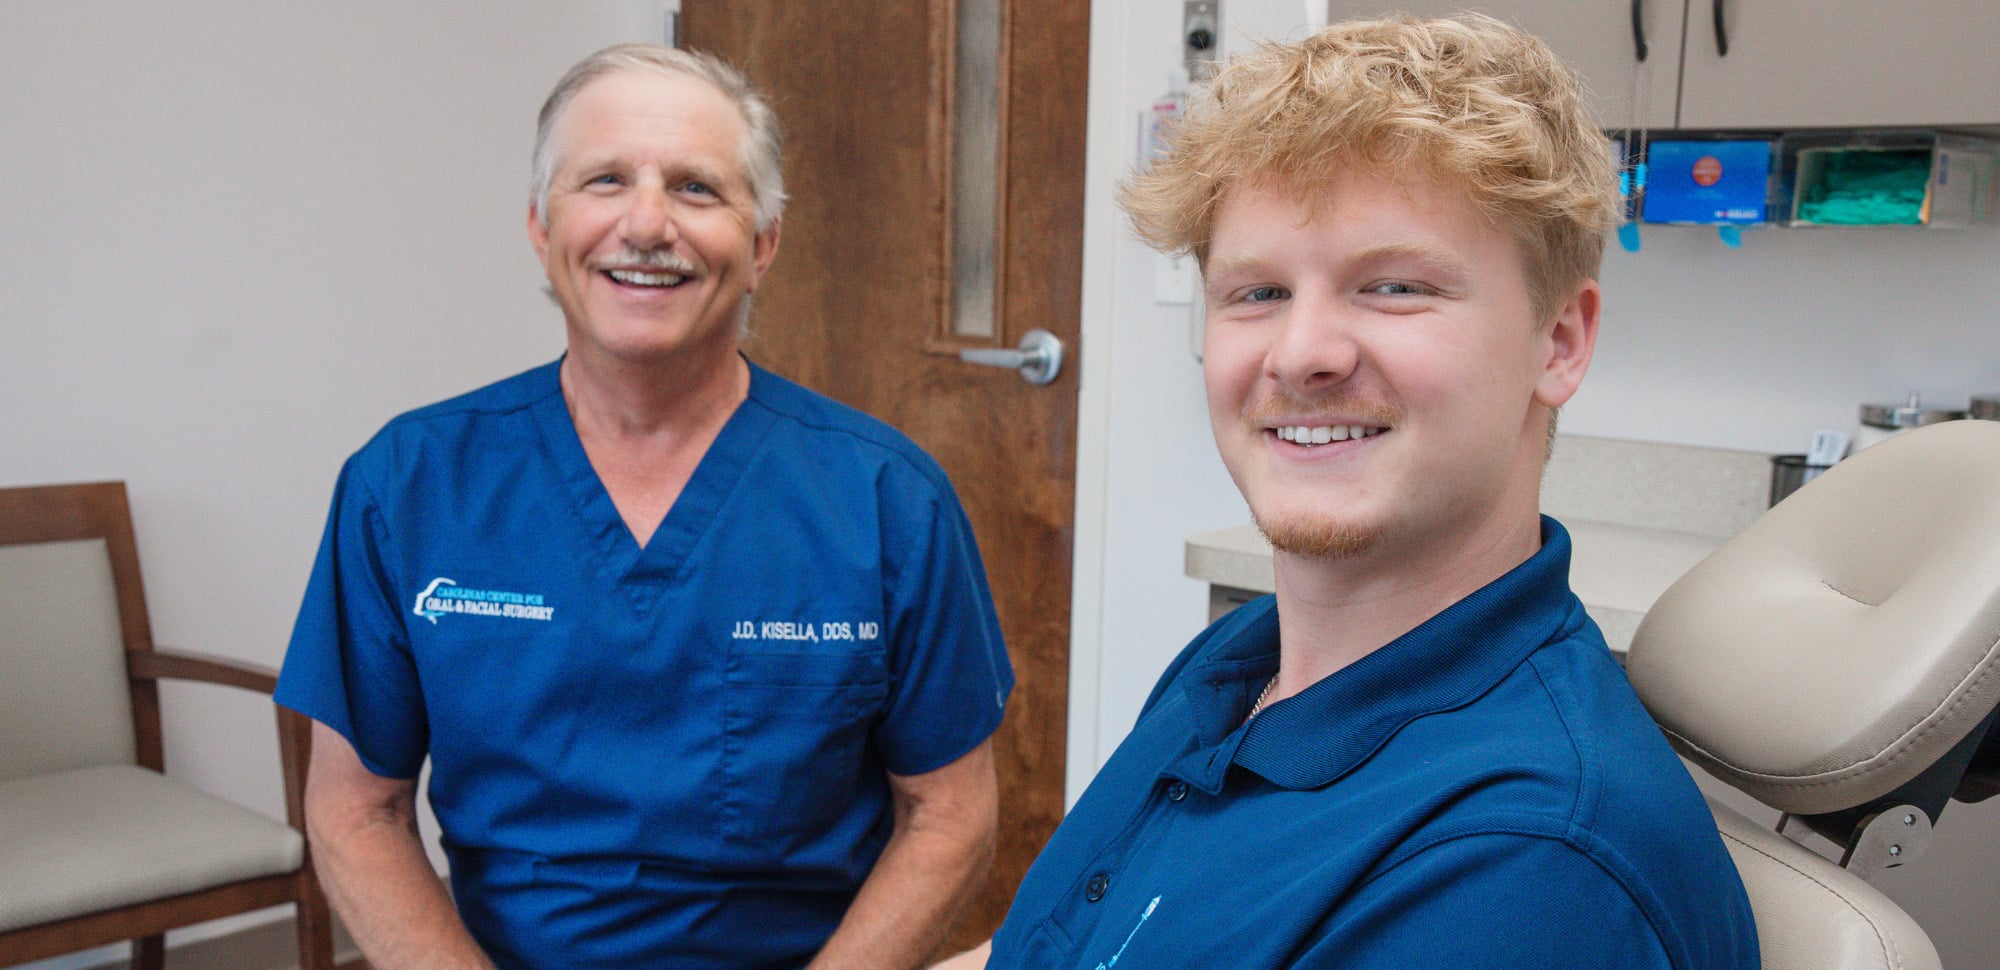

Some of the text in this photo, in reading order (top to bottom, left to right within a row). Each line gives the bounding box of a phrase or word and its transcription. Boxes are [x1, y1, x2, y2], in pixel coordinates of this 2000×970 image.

[436, 587, 545, 605] CAROLINAS CENTER FOR
[425, 597, 554, 620] ORAL & FACIAL SURGERY
[732, 621, 879, 643] J.D. KISELLA, DDS, MD
